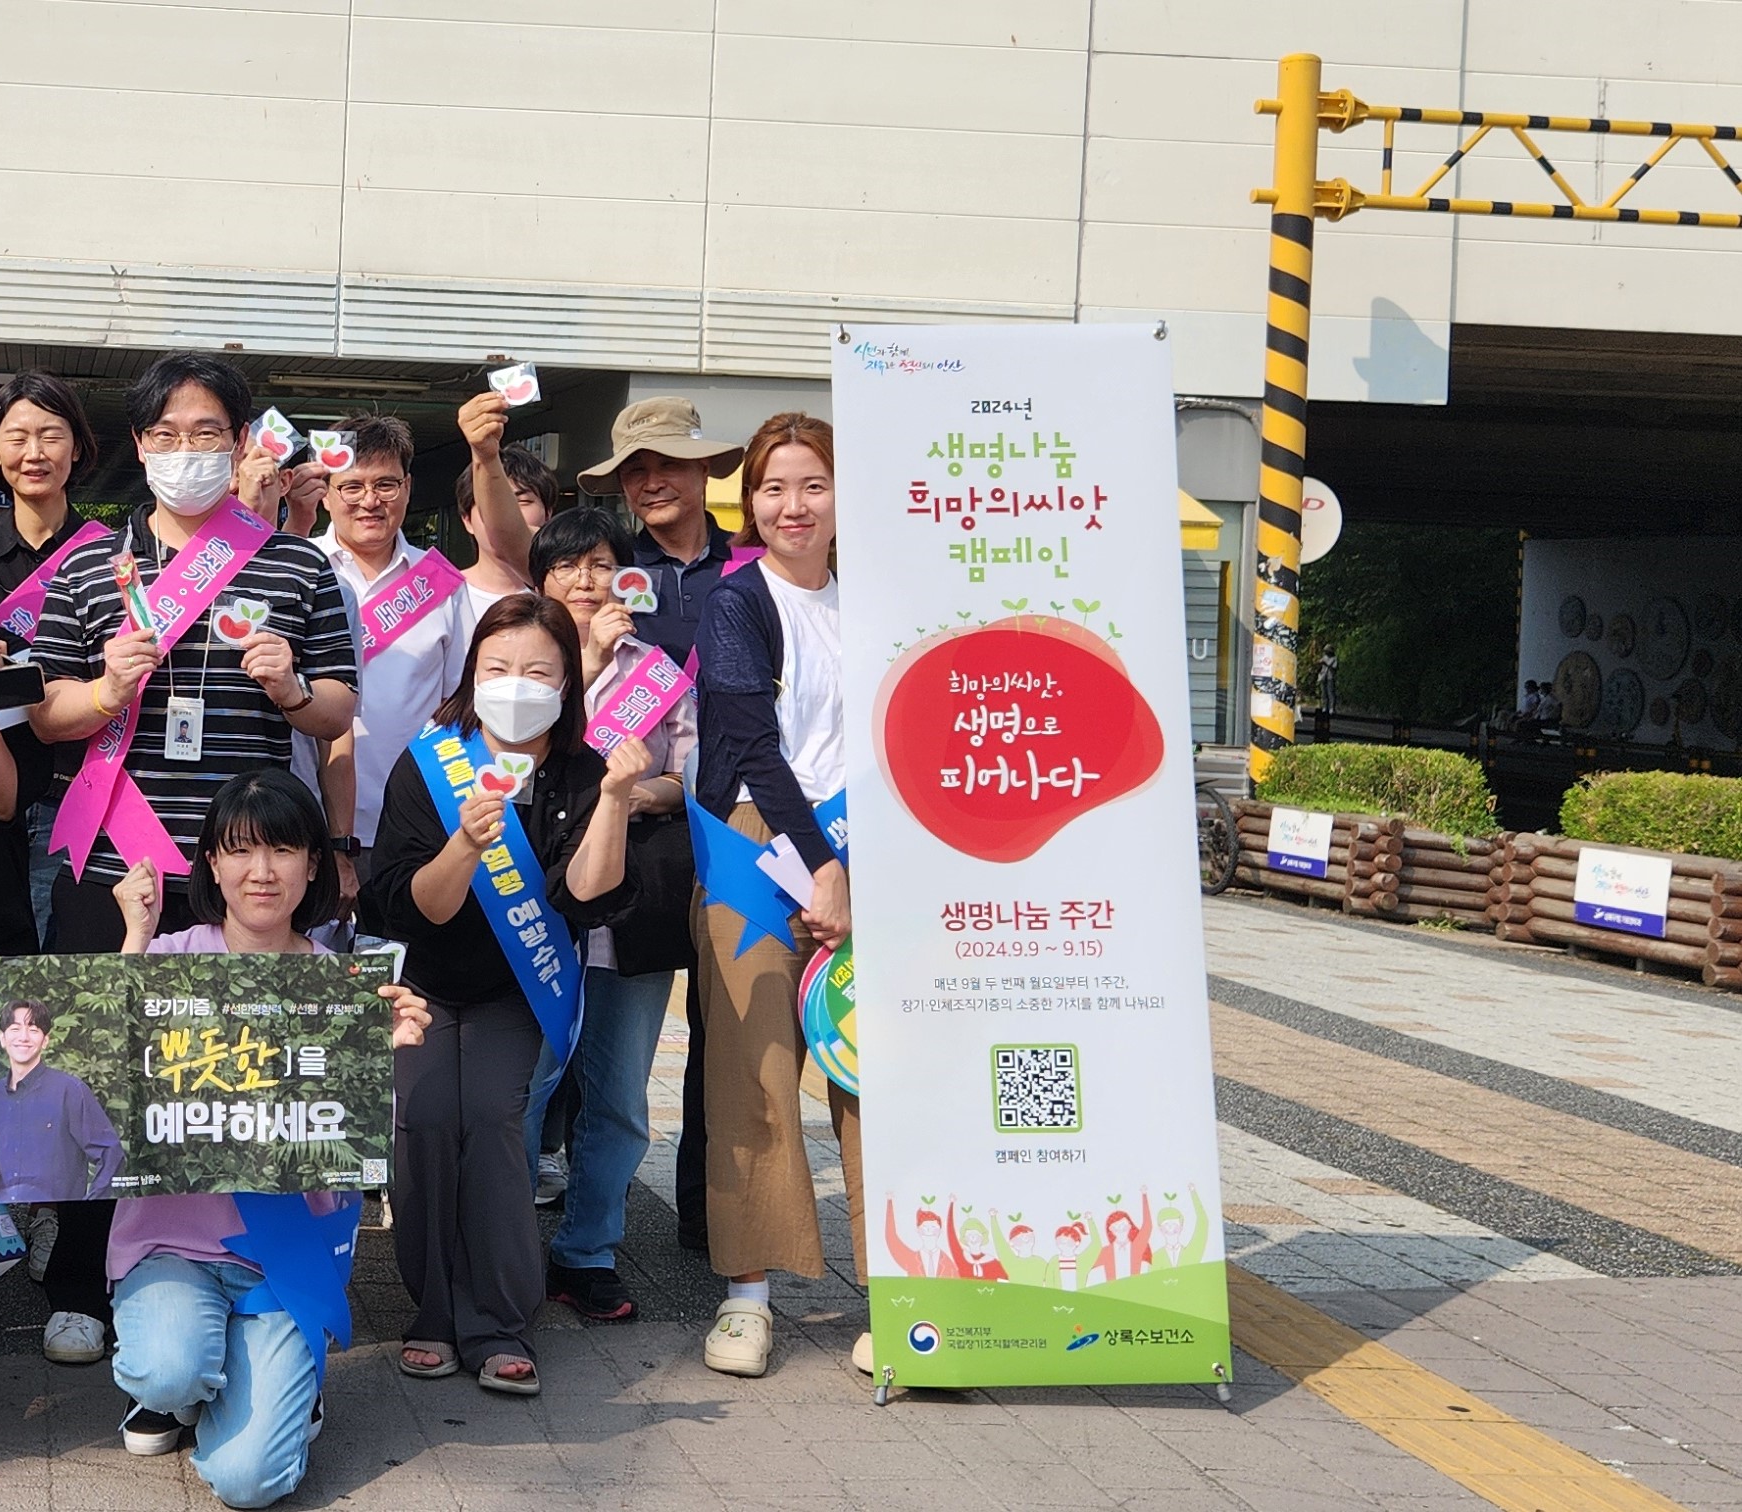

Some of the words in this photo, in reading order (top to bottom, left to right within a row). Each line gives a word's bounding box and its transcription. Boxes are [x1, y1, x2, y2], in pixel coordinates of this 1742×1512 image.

[937, 360, 965, 372] 안산
[971, 398, 1033, 420] 2024년
[927, 432, 1076, 478] 생명나눔
[907, 481, 1108, 531] 희망의씨앗
[181, 537, 235, 593] 손씻기
[949, 538, 1068, 582] 캠페인
[373, 576, 434, 633] 식중독
[611, 685, 661, 730] 함께
[954, 705, 1061, 746] 생명으로
[940, 750, 1101, 800] 피어나다
[940, 901, 1050, 932] 생명나눔
[1059, 900, 1115, 930] 주간
[507, 898, 562, 997] 예방수칙!
[955, 941, 1041, 961] (2024.9.9
[1063, 940, 1104, 959] 9.15)
[934, 977, 957, 990] 매년
[961, 977, 980, 990] 9월
[985, 977, 997, 990] 두
[1001, 977, 1025, 990] 번째
[1029, 976, 1089, 990] 월요일부터
[1094, 976, 1129, 990] 1주간,
[144, 998, 214, 1017] 장기기증,
[222, 1003, 282, 1016] #선한영향력
[289, 1003, 318, 1015] #선행
[1016, 997, 1052, 1012] 소중한
[1058, 997, 1092, 1011] 가치를
[1097, 996, 1121, 1010] 함께
[1126, 995, 1165, 1010] 나눠요!
[146, 1101, 347, 1144] 예약하세요
[995, 1149, 1032, 1164] 캠페인
[1037, 1149, 1086, 1164] 참여하기
[946, 1327, 992, 1337] 보건복지부
[1104, 1328, 1195, 1346] 상록수보건소
